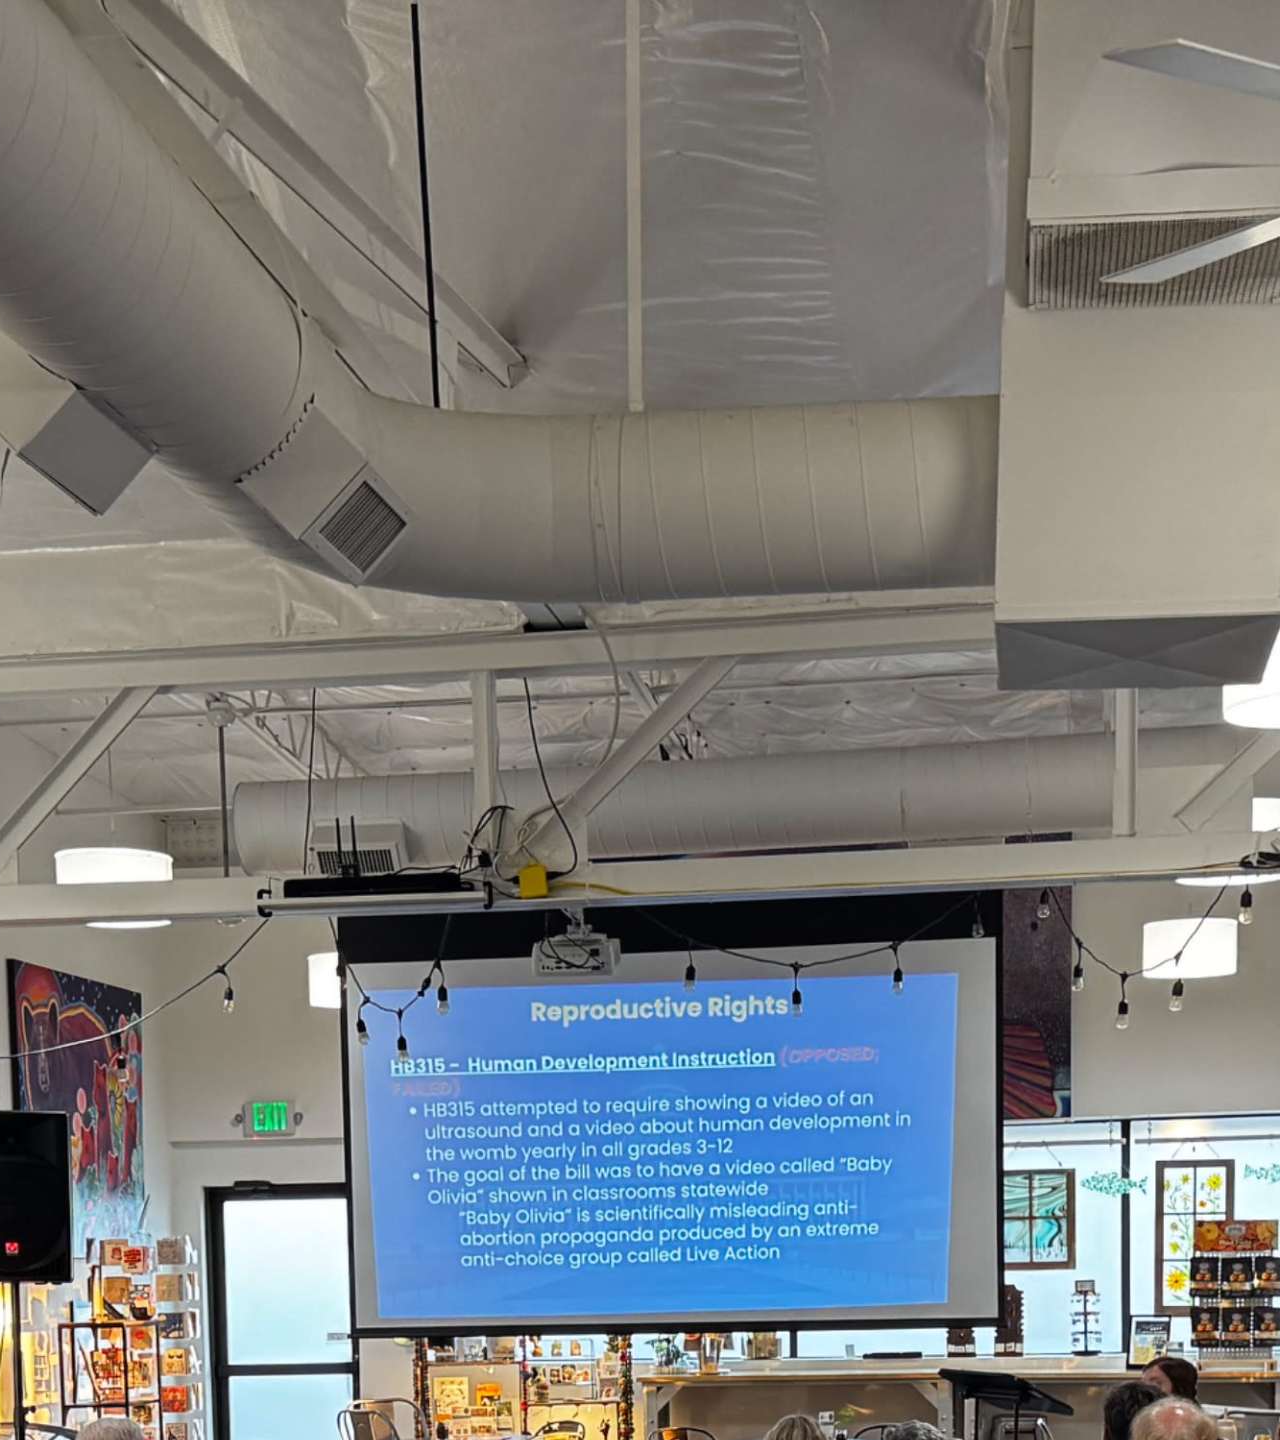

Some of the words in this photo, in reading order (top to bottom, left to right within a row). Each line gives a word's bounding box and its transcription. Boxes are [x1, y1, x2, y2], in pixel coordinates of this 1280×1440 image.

[531, 997, 702, 1027] Reproductive
[708, 995, 788, 1022] Rights
[391, 1058, 445, 1075] HB315
[468, 1056, 537, 1072] Human
[542, 1053, 668, 1073] Development
[673, 1048, 775, 1067] Instruction
[423, 1101, 475, 1118] HB315
[480, 1099, 577, 1119] attempted
[583, 1099, 600, 1114] to
[606, 1096, 669, 1117] require
[675, 1094, 750, 1114] showing
[756, 1097, 767, 1109] a
[773, 1092, 823, 1108] video
[827, 1090, 846, 1107] of
[850, 1093, 873, 1105] an
[425, 1122, 522, 1140] ultrasound
[528, 1121, 563, 1137] and
[569, 1123, 580, 1136] a
[585, 1119, 635, 1135] video
[640, 1117, 694, 1134] about
[699, 1115, 764, 1132] human
[769, 1112, 890, 1133] development
[895, 1110, 911, 1127] in
[425, 1147, 455, 1161] the
[460, 1144, 517, 1160] womb
[522, 1143, 576, 1162] yearly
[582, 1141, 598, 1157] in
[602, 1140, 623, 1156] all
[628, 1138, 692, 1160] grades
[696, 1138, 733, 1154] 3-12
[427, 1168, 459, 1183] The
[464, 1166, 504, 1187] goal
[508, 1164, 527, 1180] of
[531, 1165, 560, 1180] the
[565, 1162, 590, 1179] bill
[595, 1165, 631, 1179] was
[636, 1163, 654, 1177] to
[659, 1160, 703, 1177] have
[709, 1162, 720, 1175] a
[725, 1159, 775, 1175] video
[780, 1157, 835, 1173] called
[489, 1187, 547, 1203] shown
[552, 1185, 568, 1202] in
[572, 1184, 676, 1202] classrooms
[681, 1181, 769, 1198] statewide
[577, 1206, 590, 1222] is
[595, 1203, 705, 1223] scientifically
[710, 1200, 809, 1221] misleading
[814, 1199, 857, 1216] anti-
[460, 1230, 535, 1247] abortion
[540, 1227, 654, 1248] propaganda
[659, 1223, 746, 1246] produced
[751, 1222, 773, 1242] by
[778, 1224, 800, 1238] an
[806, 1221, 880, 1237] extreme
[461, 1251, 564, 1268] anti-choice
[569, 1249, 622, 1269] group
[627, 1247, 681, 1264] called
[686, 1245, 719, 1262] Live
[724, 1244, 780, 1261] Action
